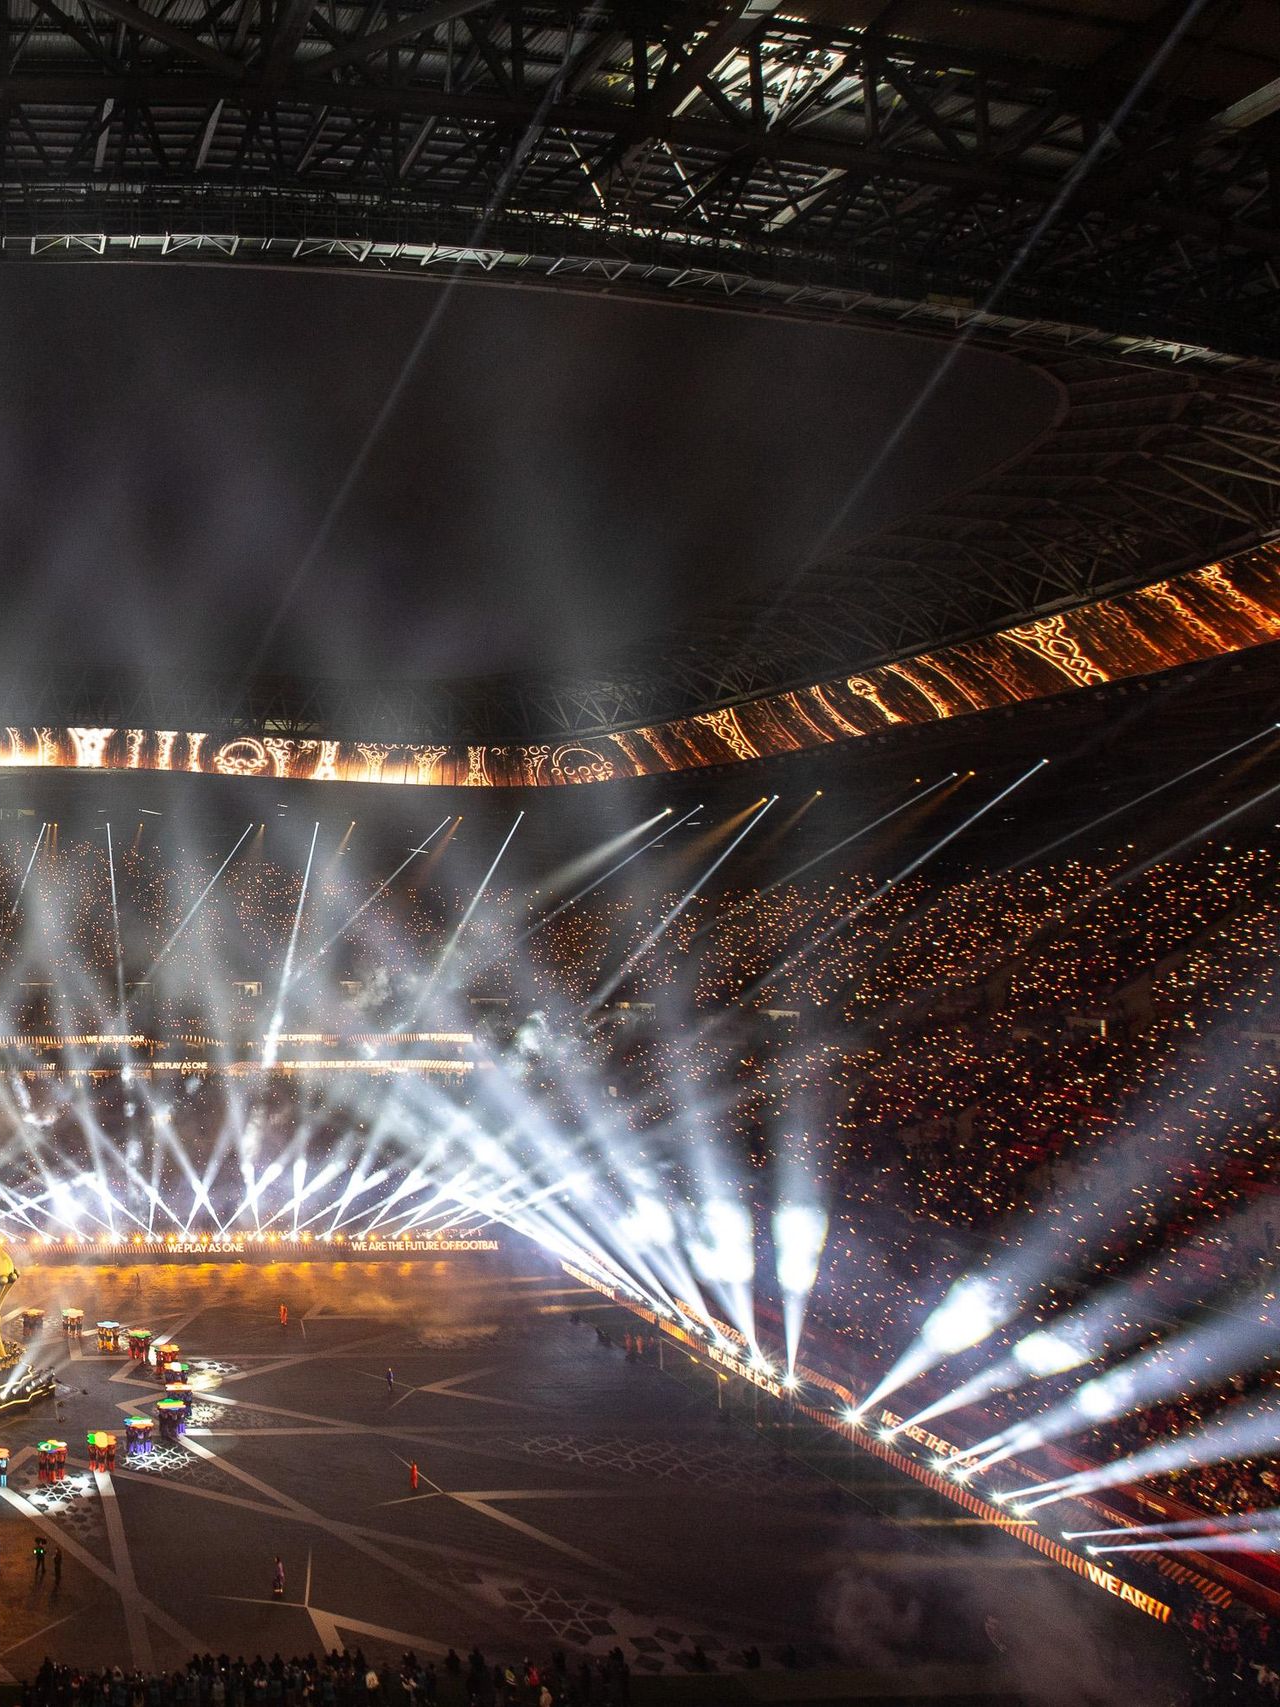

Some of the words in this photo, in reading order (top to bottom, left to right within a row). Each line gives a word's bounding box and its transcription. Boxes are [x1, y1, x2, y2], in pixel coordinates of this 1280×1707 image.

[86, 1035, 98, 1043] WE
[98, 1035, 112, 1043] ARE
[112, 1035, 125, 1043] THE
[125, 1035, 145, 1043] ROAR
[283, 1061, 295, 1069] WE
[168, 1243, 183, 1253] WE
[184, 1243, 207, 1253] PLAY
[207, 1243, 223, 1253] AS
[223, 1243, 244, 1253] ONE
[352, 1241, 368, 1251] WE
[369, 1241, 387, 1251] ARE
[388, 1241, 404, 1251] THE
[405, 1241, 439, 1251] FUTURE
[440, 1241, 455, 1251] OF
[707, 1345, 724, 1364] WE
[722, 1353, 740, 1375] ARE
[738, 1363, 756, 1383] THE
[880, 1409, 905, 1430] WE
[925, 1432, 952, 1457] THE
[1086, 1561, 1122, 1598] WE
